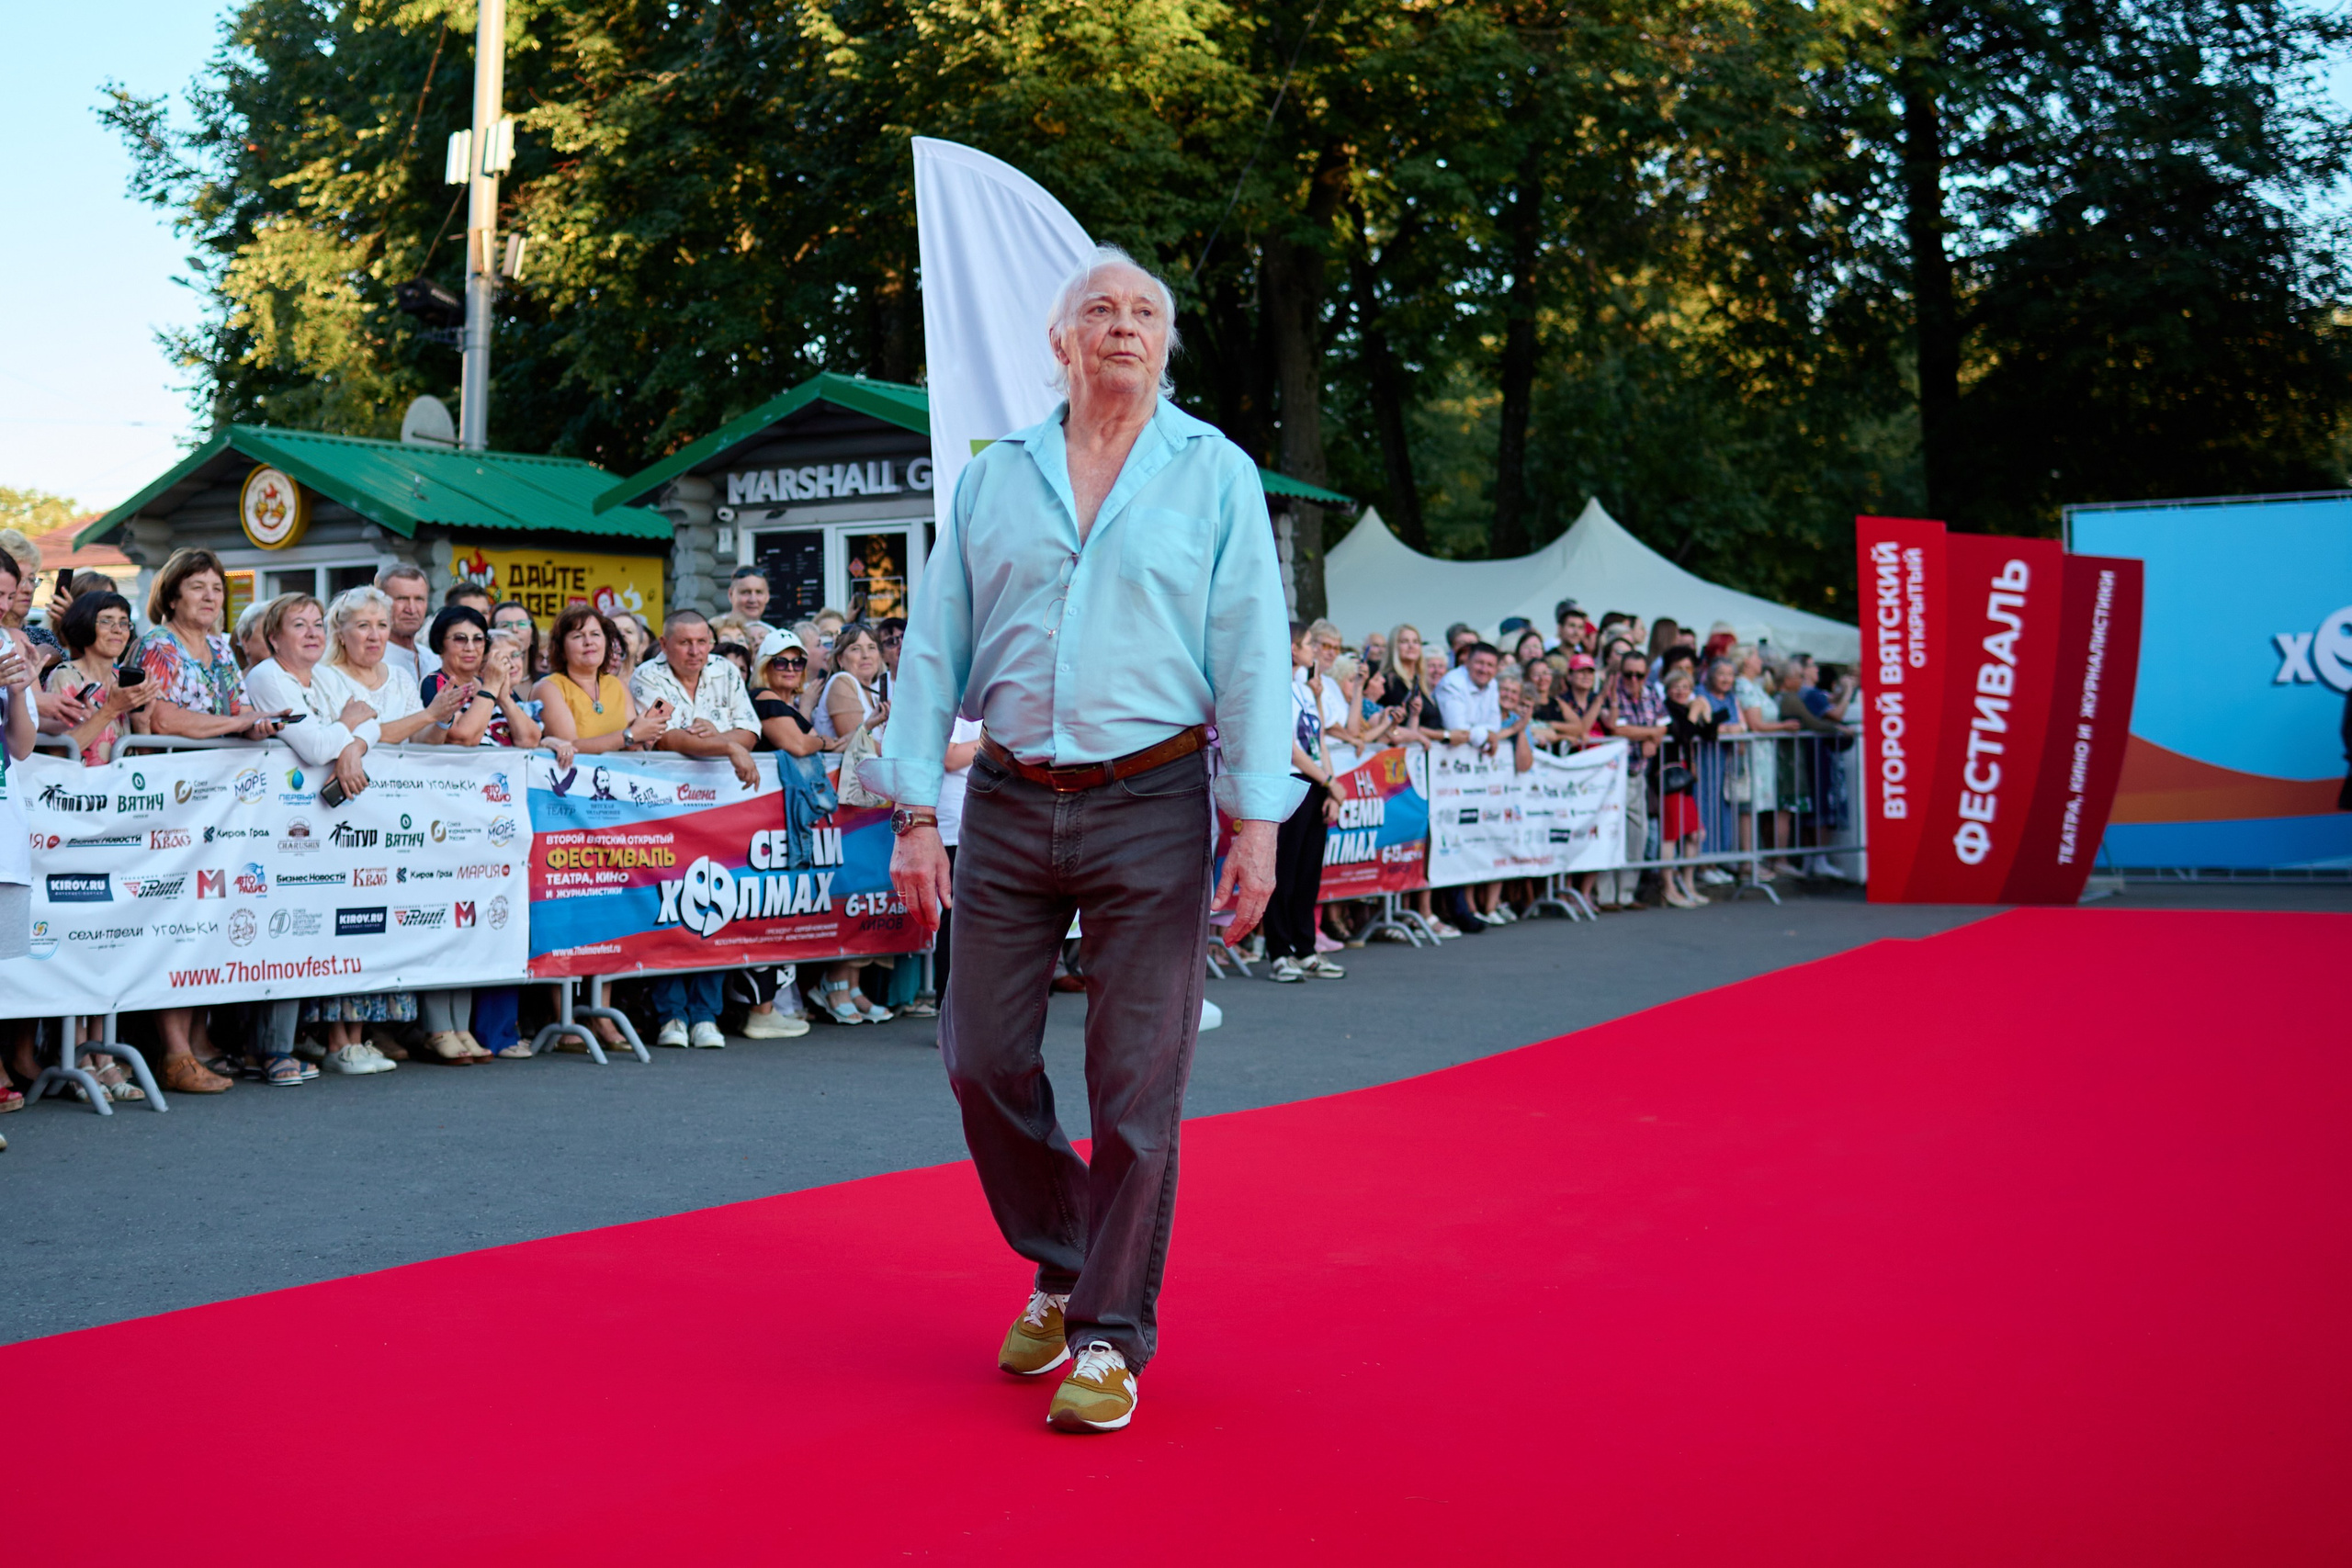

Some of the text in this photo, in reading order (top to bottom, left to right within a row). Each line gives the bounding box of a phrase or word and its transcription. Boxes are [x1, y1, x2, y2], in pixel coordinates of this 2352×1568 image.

[727, 459, 901, 505] MARSHALL
[508, 559, 585, 591] ДАЙТЕ
[1902, 547, 1927, 669] ОТКРЫТЫЙ
[1871, 540, 1907, 820] ВТОРОЙ ВЯТСКИЙ
[1952, 558, 2031, 865] ФЕСТИВАЛЬ
[2057, 570, 2117, 865] ТЕАТРА, КИНО И ЖУРНАЛИСТИКИ
[234, 773, 267, 796] МОРЕ
[677, 783, 716, 801] Смена
[1353, 769, 1377, 798] НА
[118, 794, 164, 813] ВЯТИЧ
[1338, 796, 1385, 831] СЕМИ
[216, 828, 269, 838] Киров Град
[385, 832, 424, 848] ВЯТИЧ
[487, 819, 516, 840] МОРЕ
[546, 832, 674, 845] ВТОРОЙ ВЯТСКИЙ ОТКРЫТЫЙ
[277, 840, 321, 850] CHARUSHIN
[748, 827, 844, 871] СЕИ
[1322, 830, 1378, 868] ЛМАХ
[546, 847, 676, 871] ФЕСТИВАЛЬ
[410, 869, 453, 880] Киров Град
[457, 863, 500, 879] МАРИЯ
[546, 872, 629, 886] ТЕАТРА, КИНО
[51, 879, 106, 891] KIROV.RU
[546, 886, 624, 899] И ЖУРНАЛИСТИКИ
[845, 891, 888, 918] 6-13
[339, 912, 384, 925] KIROV.RU
[858, 918, 904, 931] КИРОВ
[169, 955, 362, 987] www.7holmovfest.ru
